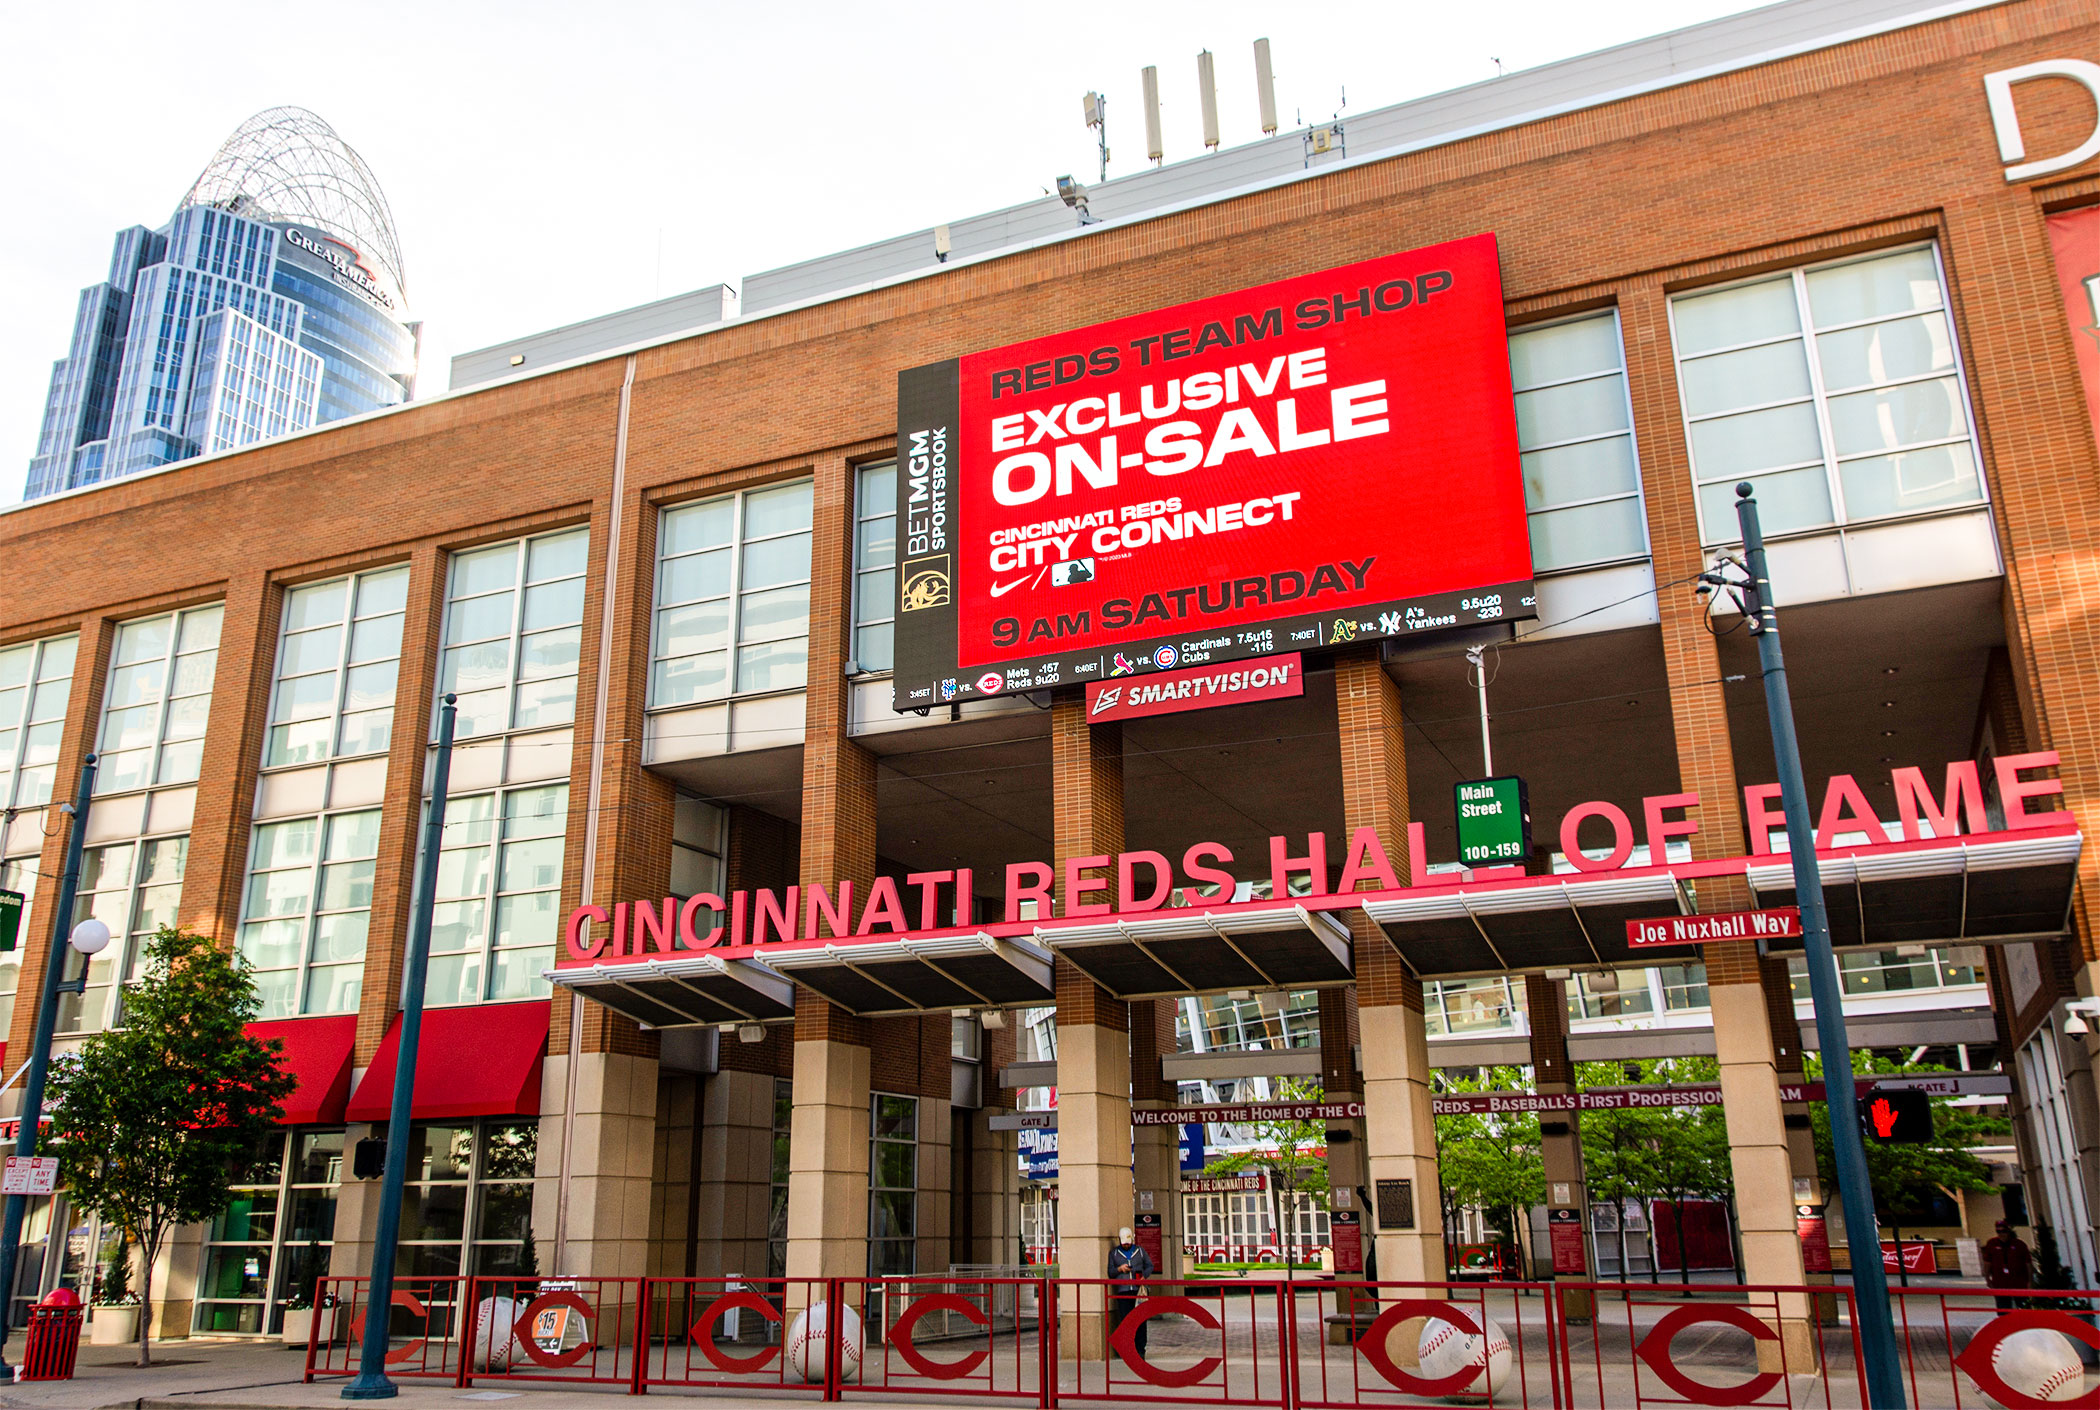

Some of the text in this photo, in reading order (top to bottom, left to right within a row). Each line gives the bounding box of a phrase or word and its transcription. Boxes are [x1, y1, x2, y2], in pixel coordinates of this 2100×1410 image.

[285, 228, 342, 267] GREAT
[992, 270, 1454, 399] REDS TEAM SHOP
[992, 347, 1328, 452] EXCLUSIVE
[992, 379, 1390, 507] ON-SALE
[908, 430, 930, 556] BETMGM
[931, 426, 947, 550] SPORTSBOOK
[990, 496, 1183, 546] CINCINNATI REDS
[989, 491, 1301, 573] CITY CONNECT
[992, 557, 1379, 647] 9 AM SATURDAY
[1405, 606, 1425, 618] A's
[1477, 605, 1504, 620] -230
[1405, 613, 1457, 631] Yankees
[1181, 636, 1231, 653] Cardinals
[1181, 650, 1211, 664] Cubs
[1006, 667, 1030, 679] Mets
[1006, 673, 1060, 690] Reds 9u20
[1460, 784, 1495, 801] Main
[1461, 800, 1503, 818] Street
[565, 867, 973, 960] CINCINNATI
[1005, 841, 1237, 922] REDS
[1559, 792, 1700, 873] OF
[1745, 751, 2076, 857] FAME
[1464, 842, 1521, 860] 100-159
[1634, 913, 1790, 944] Joe Nuxhall Way
[1950, 1079, 1960, 1094] J
[1132, 1110, 1197, 1125] WELCOME
[1200, 1110, 1218, 1122] TO
[1221, 1109, 1248, 1122] THE
[1251, 1106, 1292, 1120] HOME
[1294, 1107, 1313, 1119] OF
[1316, 1105, 1344, 1118] THE
[1432, 1099, 1471, 1114] REDS
[1580, 1093, 1624, 1109] FIRST
[1021, 1115, 1051, 1128] GATE J
[1211, 1177, 1244, 1191] CINCINNATI
[1244, 1176, 1260, 1190] REDS
[538, 1311, 557, 1330] $15
